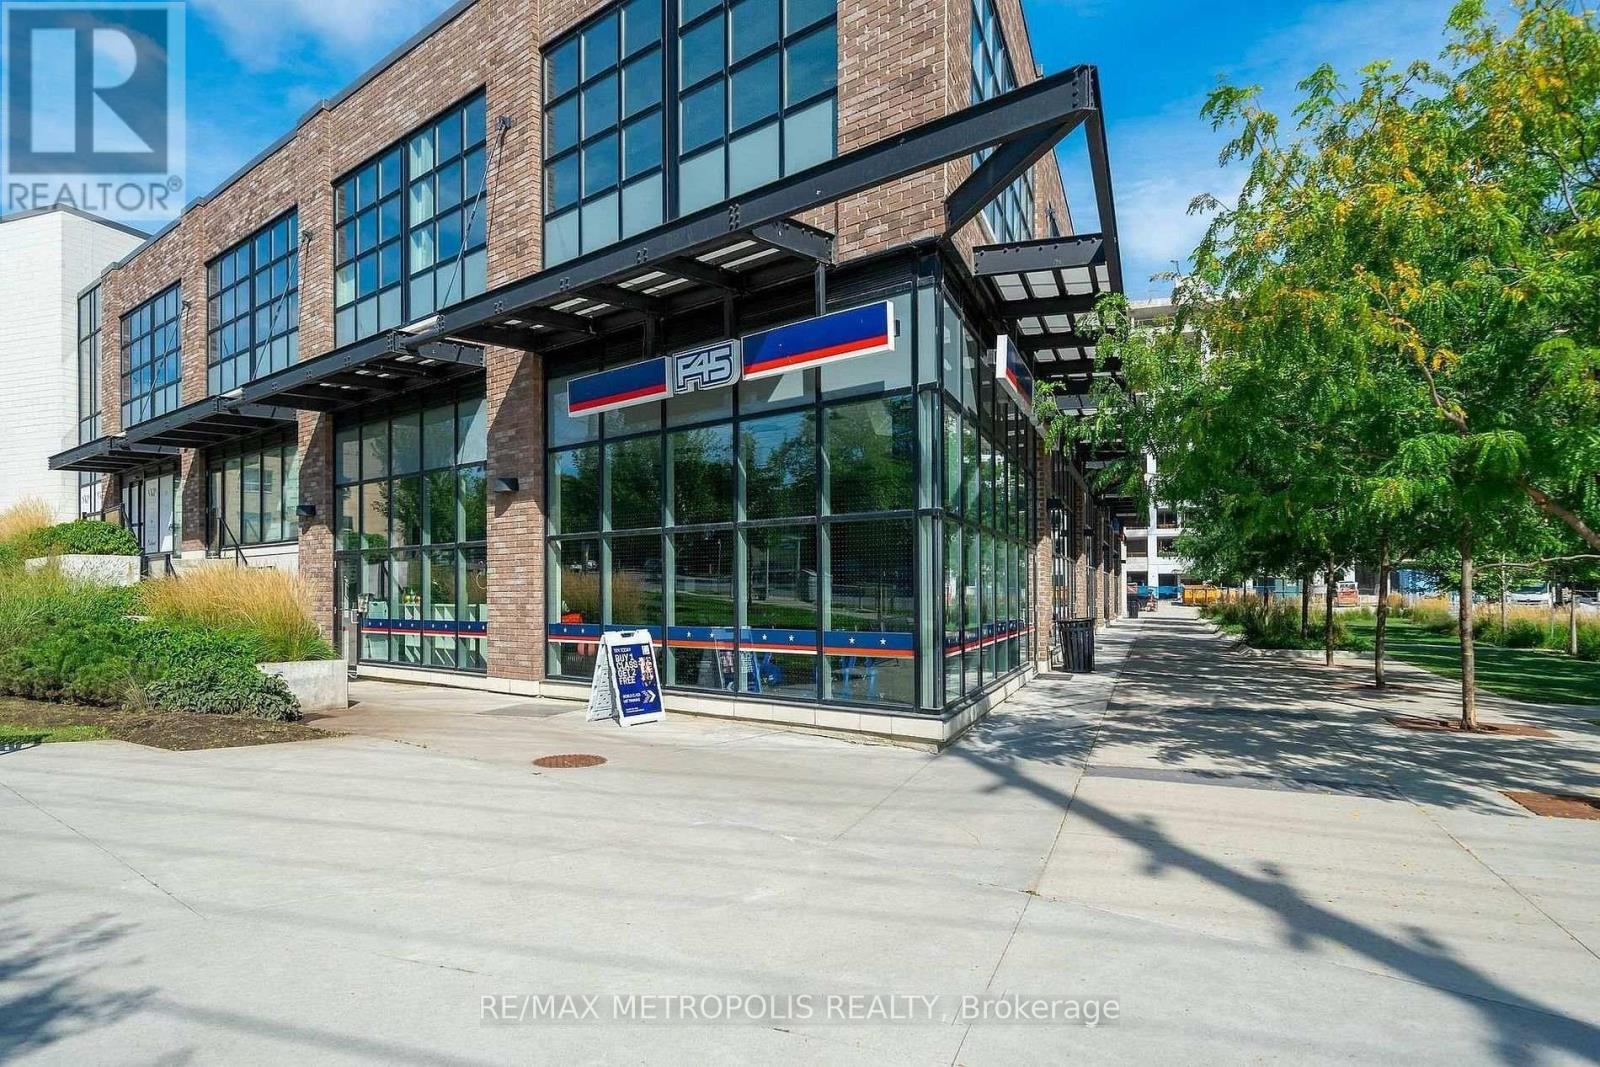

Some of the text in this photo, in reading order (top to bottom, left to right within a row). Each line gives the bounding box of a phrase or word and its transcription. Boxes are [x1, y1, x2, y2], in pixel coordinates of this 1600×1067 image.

[675, 342, 733, 390] F45
[615, 653, 628, 662] BUY
[616, 660, 638, 670] CLASS
[618, 668, 637, 677] GET 2
[619, 676, 636, 685] FREE
